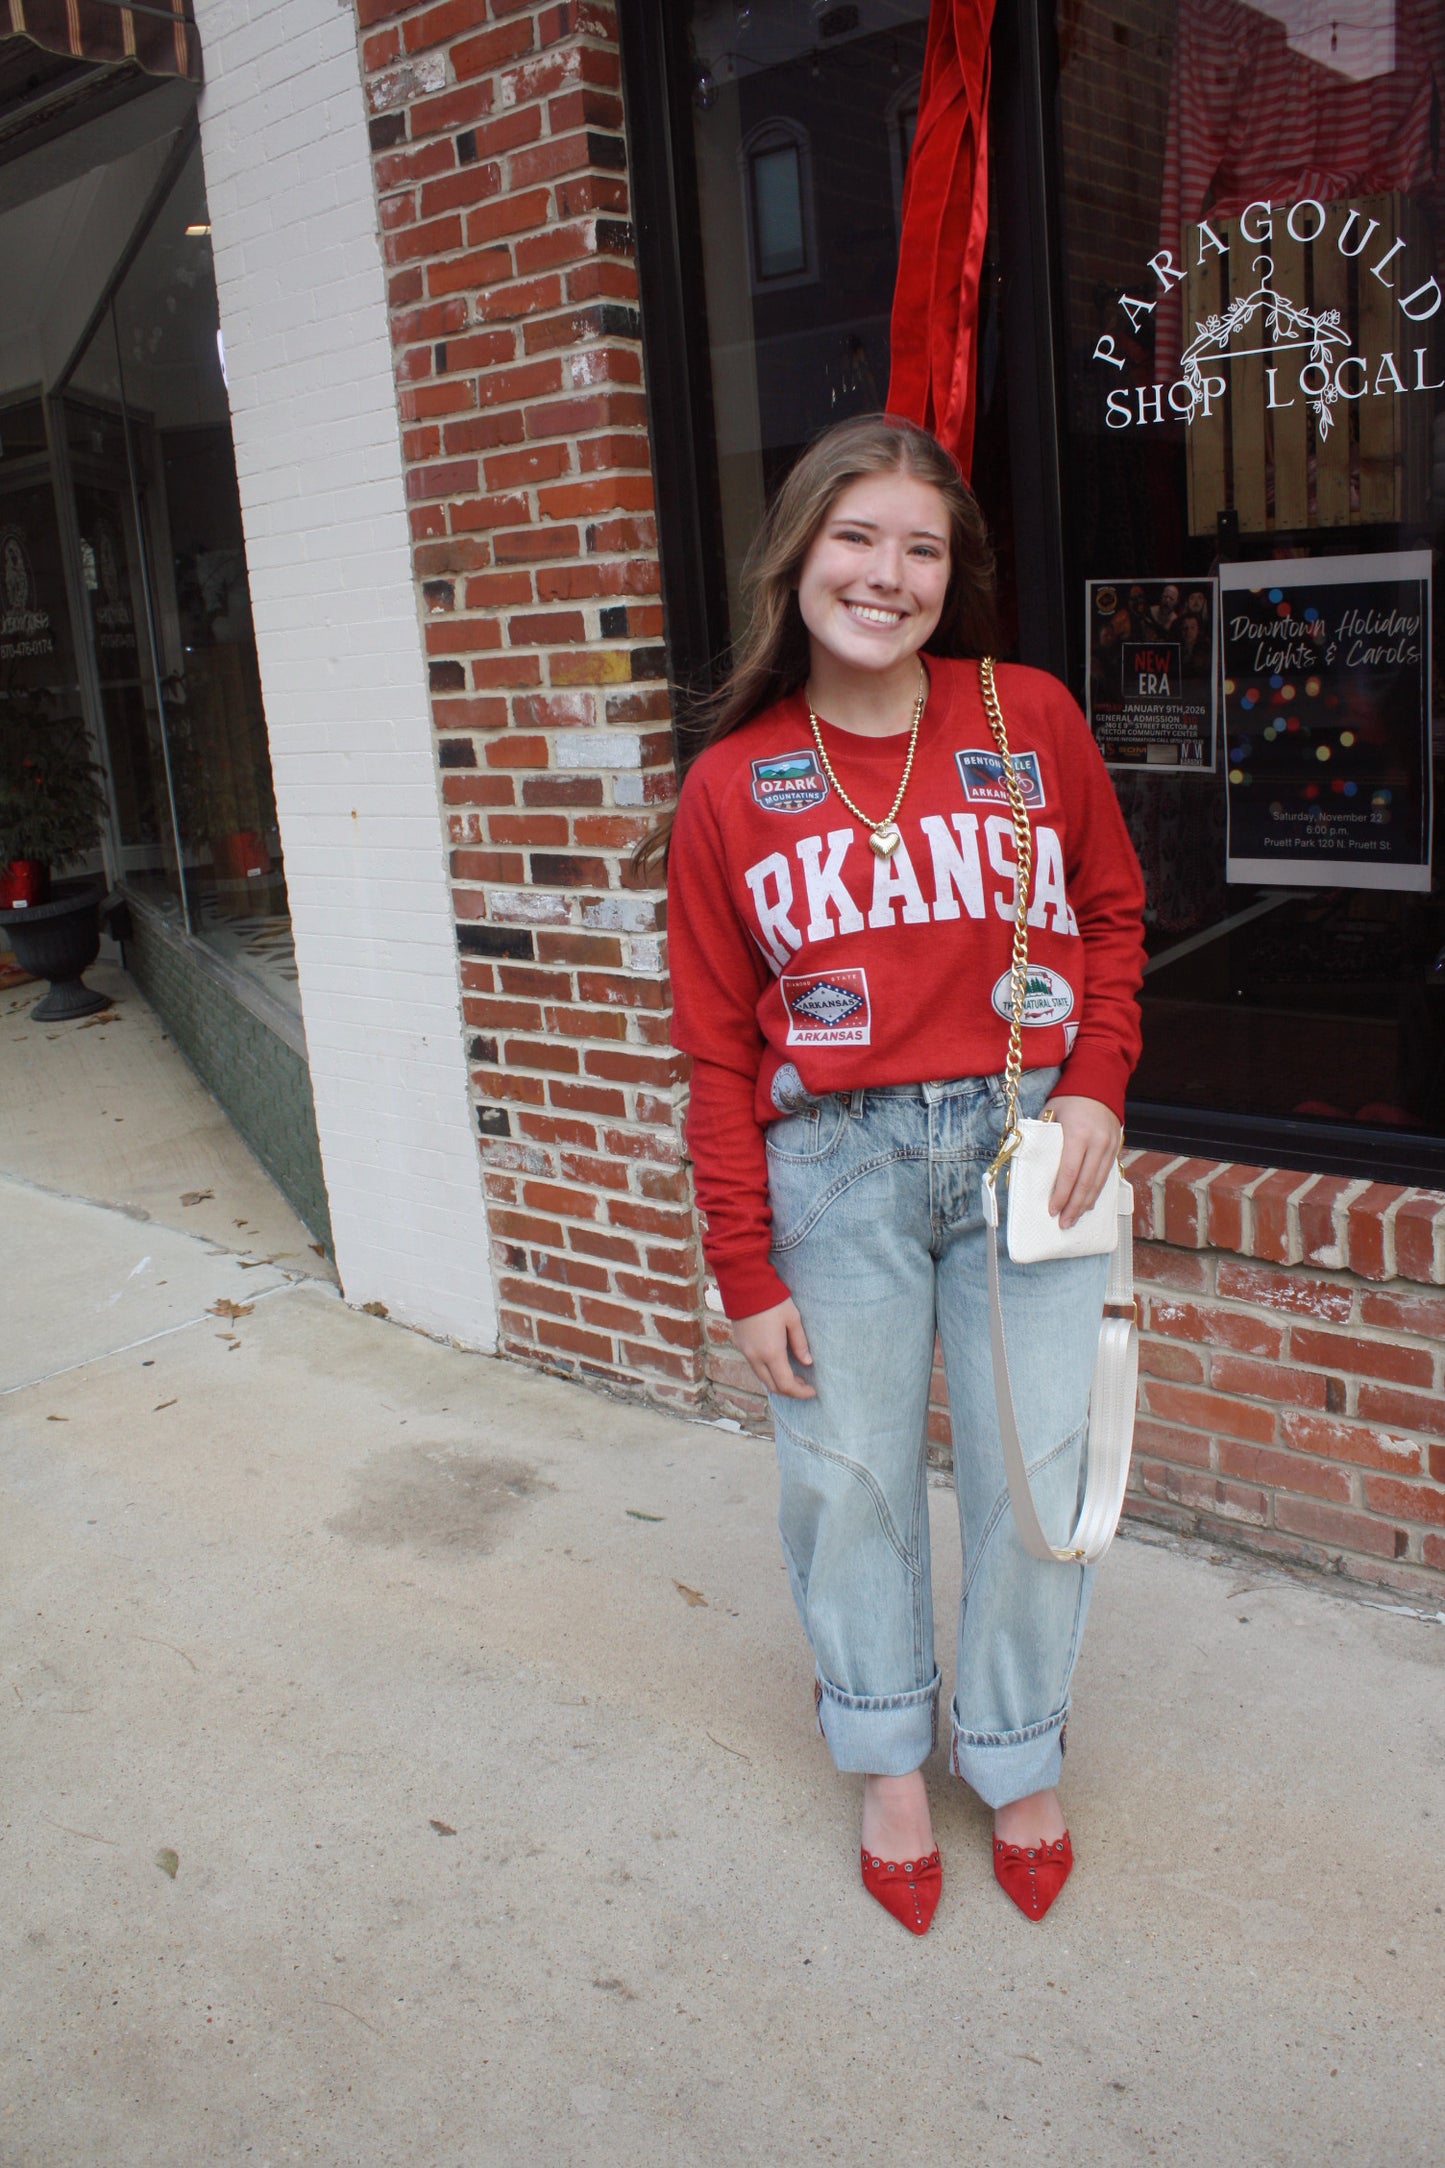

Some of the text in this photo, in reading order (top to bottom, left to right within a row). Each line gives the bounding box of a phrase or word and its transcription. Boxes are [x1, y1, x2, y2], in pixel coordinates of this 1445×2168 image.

[1093, 199, 1442, 371] PARAGOULD
[1105, 348, 1445, 429] SHOP LOCAL
[1229, 608, 1421, 642] Downtown Holiday
[1134, 649, 1171, 673] NEW
[1254, 638, 1421, 674] Lights & Carols
[1138, 672, 1171, 696] ERA
[1122, 704, 1163, 713] JANUARY
[1096, 714, 1130, 722] GENERAL
[1130, 715, 1180, 723] ADMISSION
[1134, 722, 1160, 730] STREET
[1172, 729, 1198, 737] CENTER
[963, 756, 1032, 771] BENTONLLE
[760, 776, 817, 793] OZARK
[972, 788, 1011, 800] ARKAN
[1272, 811, 1383, 823] Saturday, November 22
[1263, 837, 1292, 847] Pruett
[1294, 838, 1316, 848] Park
[1317, 839, 1334, 848] 120
[1349, 840, 1377, 849] Pruett
[745, 813, 1080, 978] RKANSA
[830, 974, 857, 982] STATE
[802, 998, 855, 1010] ARKANSAS
[1051, 997, 1069, 1008] STATE
[794, 1030, 863, 1042] ARKANSAS
